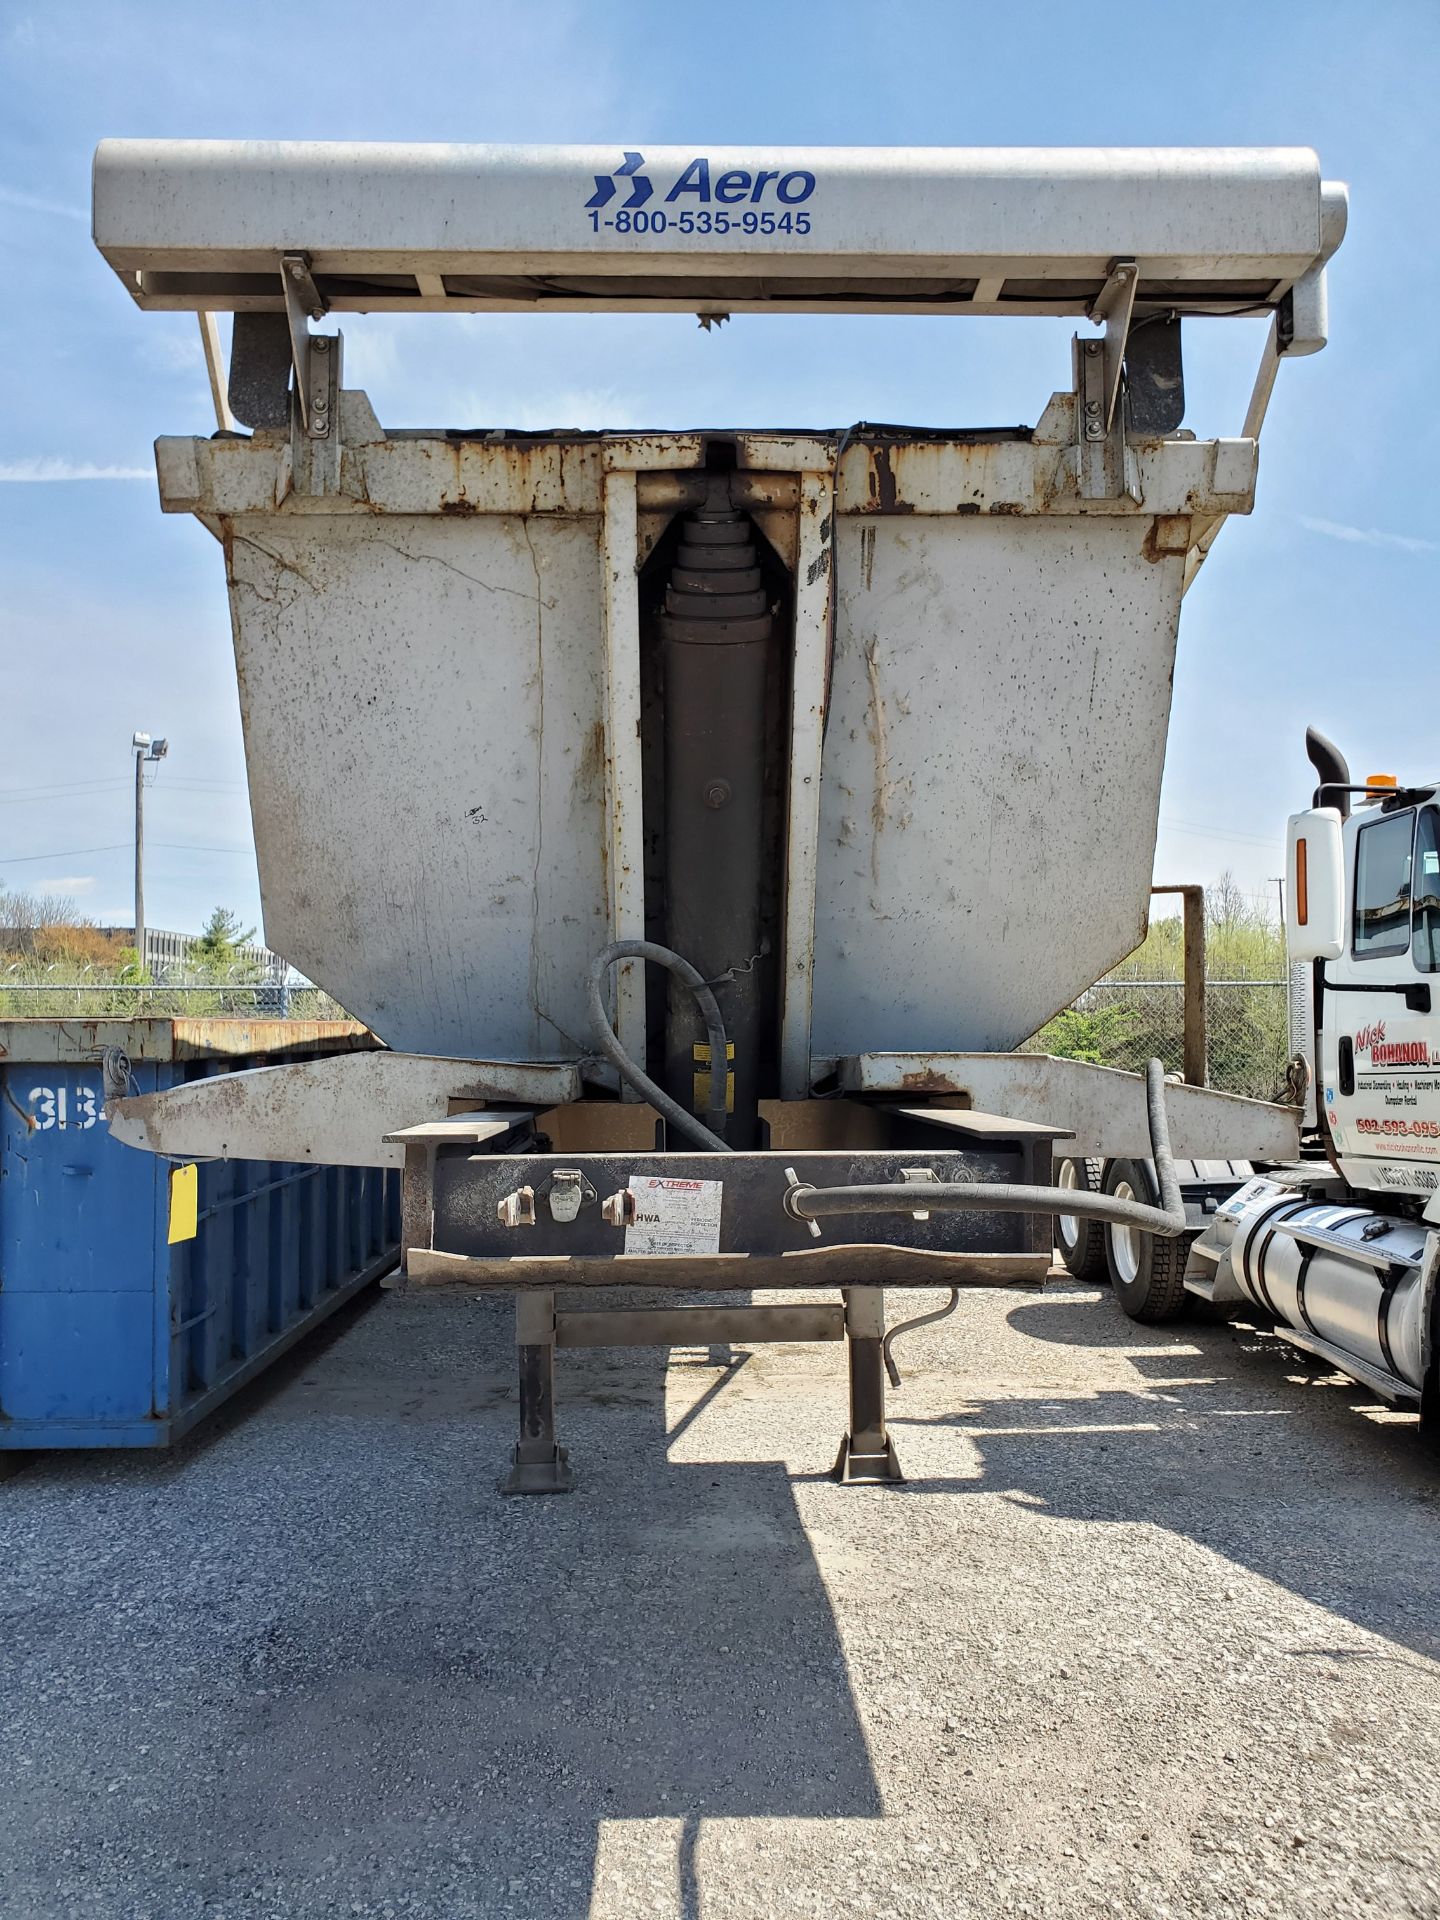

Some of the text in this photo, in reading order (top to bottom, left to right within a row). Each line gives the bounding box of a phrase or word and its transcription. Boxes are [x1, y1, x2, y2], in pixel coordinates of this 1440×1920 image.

[664, 158, 816, 205] Aero
[588, 210, 811, 235] 1-800-535-9545
[1355, 1020, 1386, 1054] Nick
[1371, 1041, 1431, 1066] BOHANON,
[1356, 1119, 1440, 1138] 502-593-095
[647, 1179, 704, 1190] EXTREME
